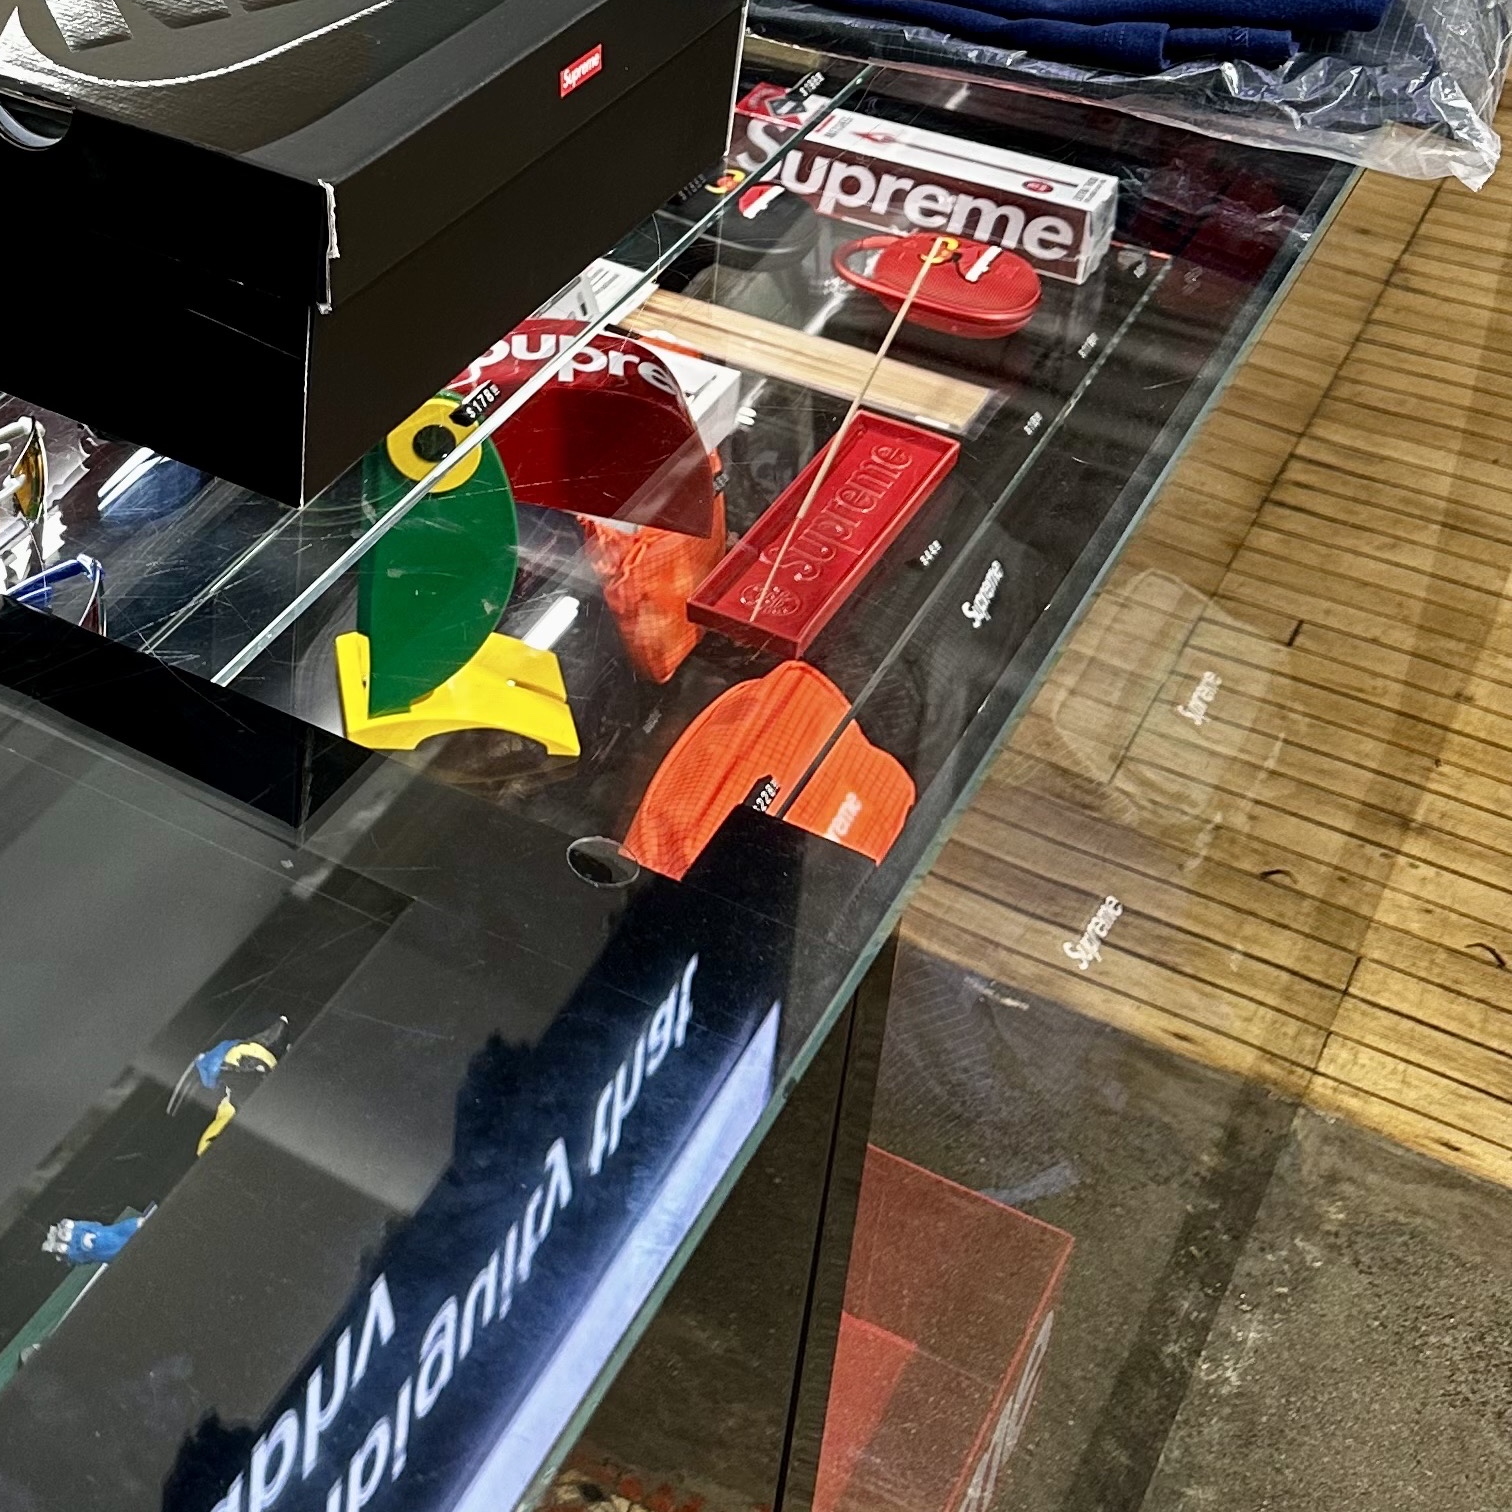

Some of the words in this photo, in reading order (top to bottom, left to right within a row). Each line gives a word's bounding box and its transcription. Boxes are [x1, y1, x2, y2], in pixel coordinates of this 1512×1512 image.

[562, 52, 601, 89] Supreme
[736, 119, 1074, 261] Supreme
[759, 443, 913, 581] Supreme
[961, 560, 1004, 628] Supreme
[1063, 896, 1123, 970] Supreme
